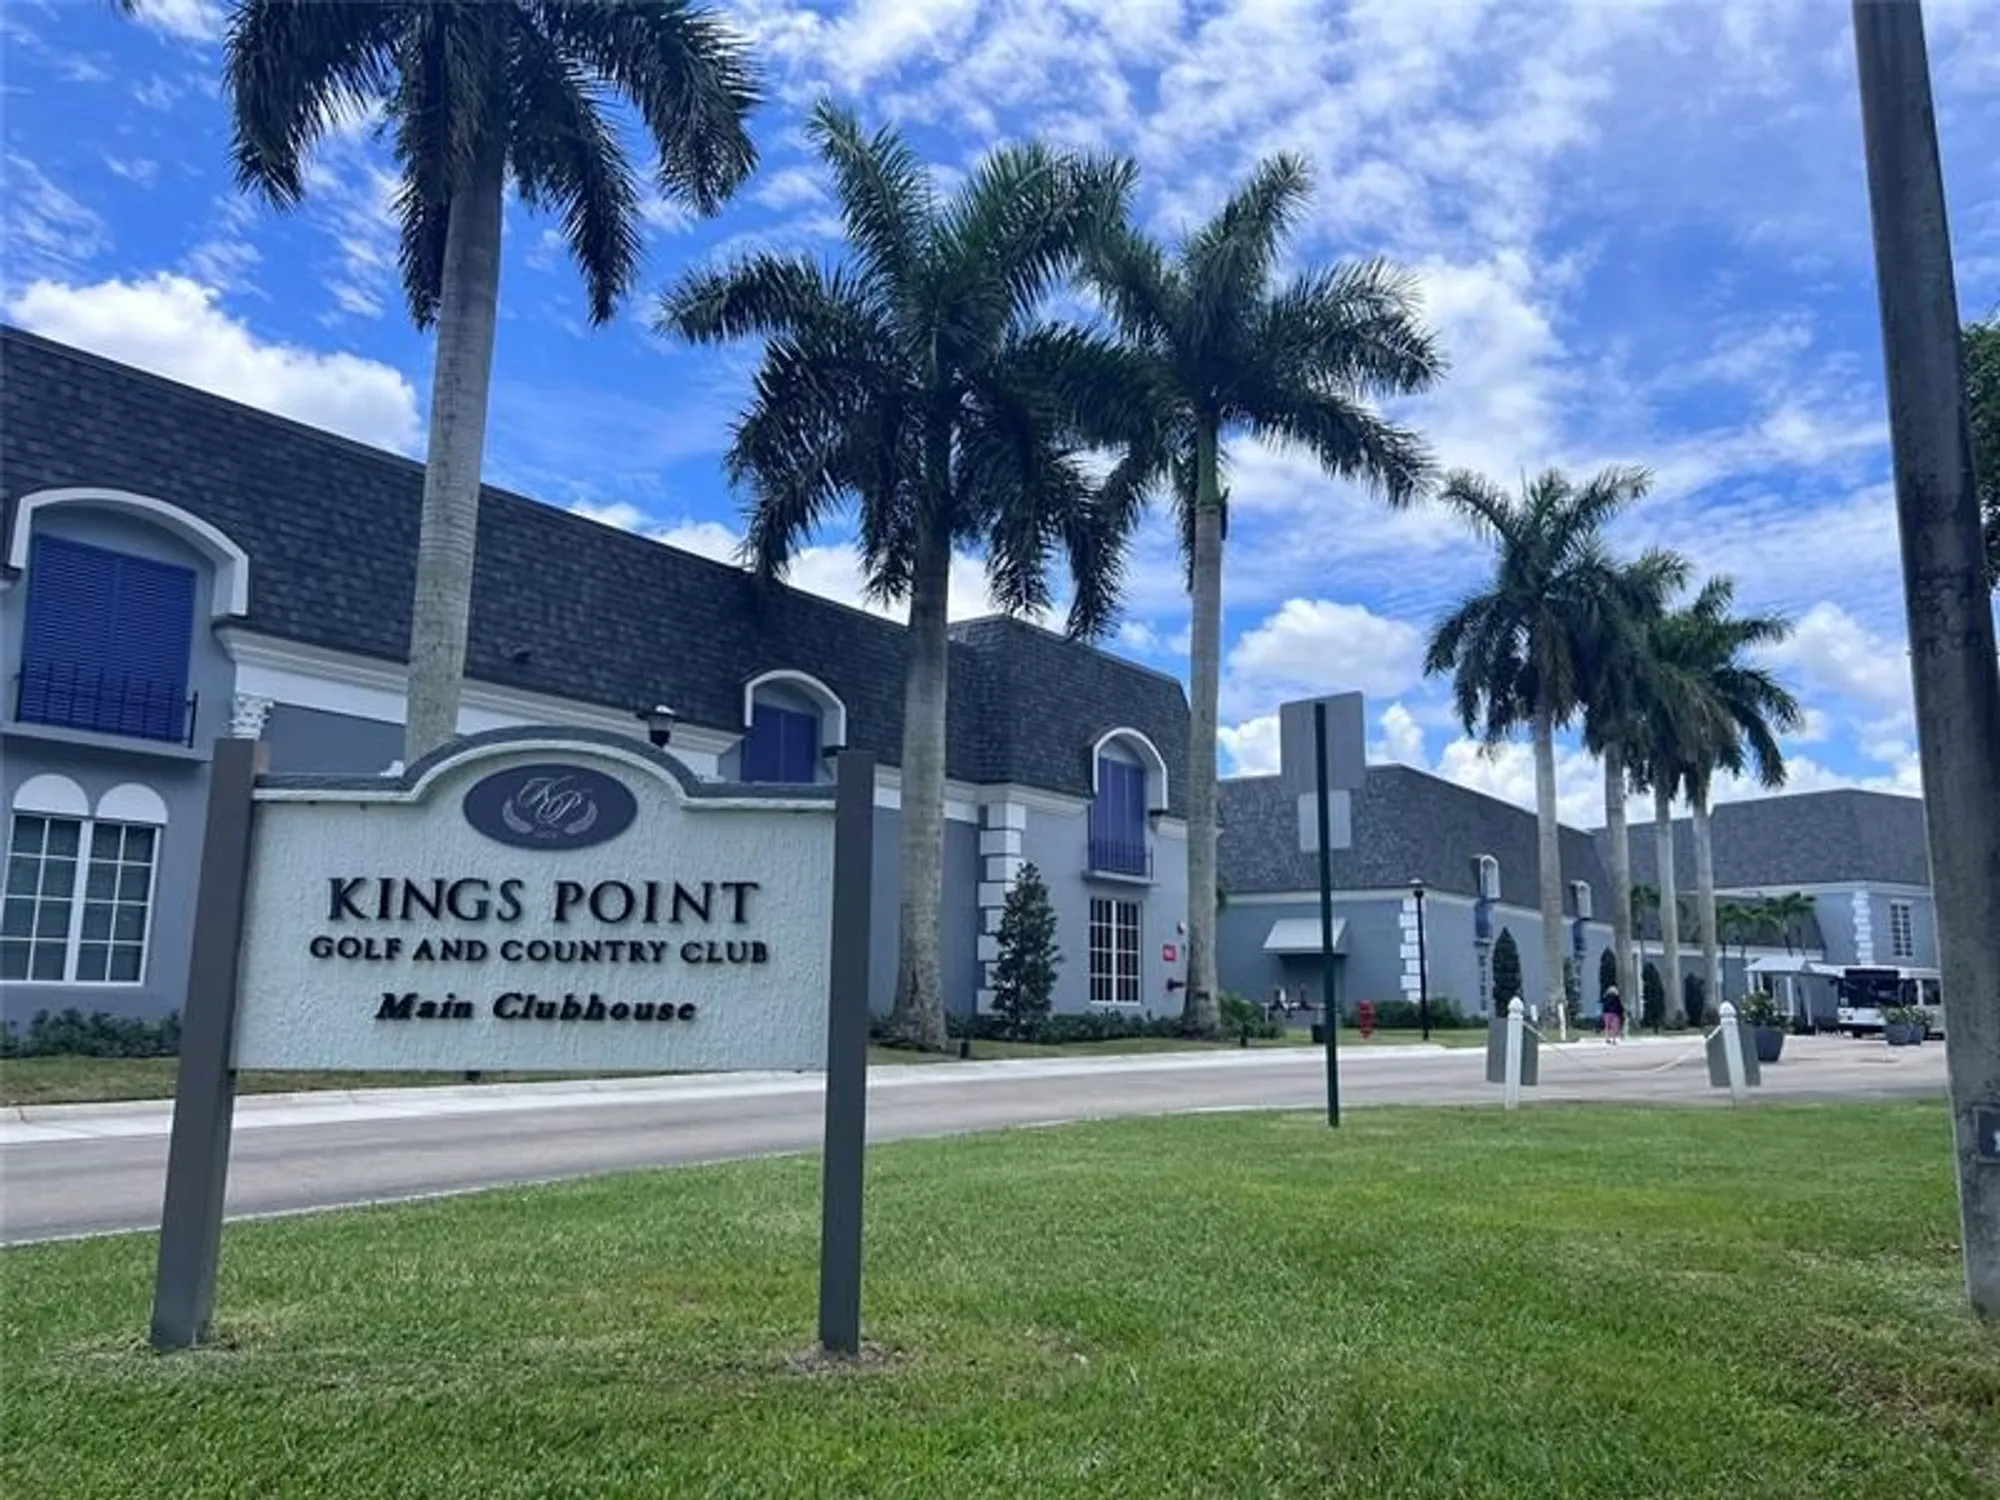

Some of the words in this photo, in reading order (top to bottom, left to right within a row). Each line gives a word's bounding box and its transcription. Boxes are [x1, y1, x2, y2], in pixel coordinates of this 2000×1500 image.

[327, 877, 525, 922] KINGS
[553, 880, 761, 924] POINT
[309, 935, 402, 960] GOLF
[412, 938, 488, 962] AND
[500, 939, 668, 963] COUNTRY
[680, 941, 768, 964] CLUB
[374, 992, 474, 1020] Main
[493, 992, 697, 1021] Clubhouse
